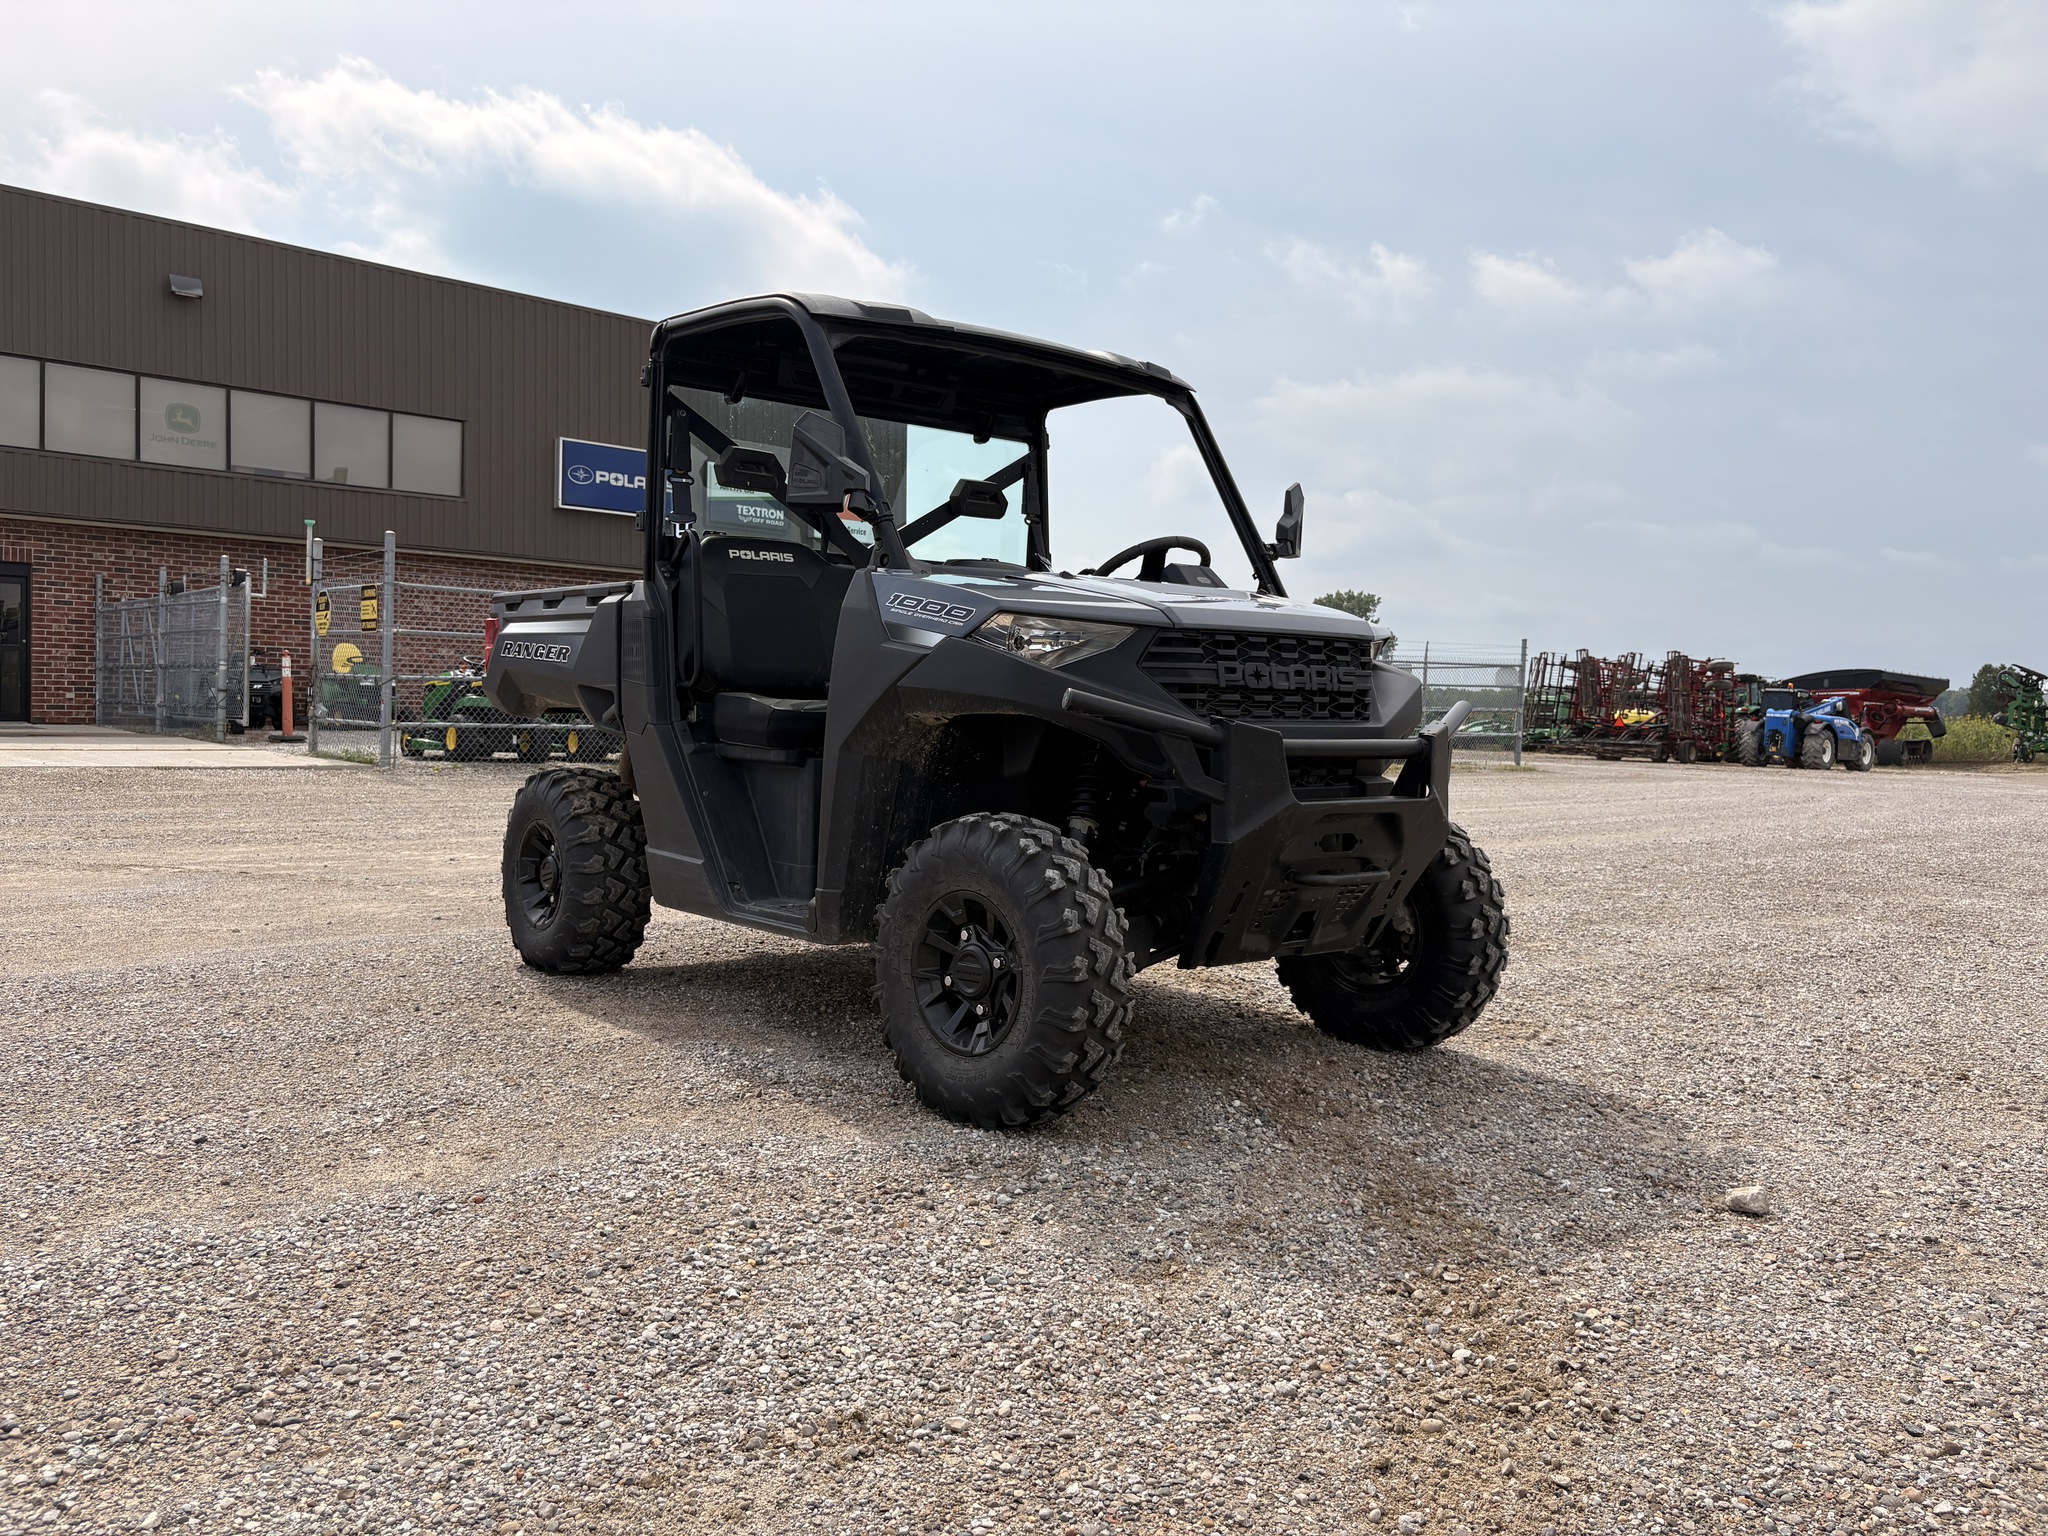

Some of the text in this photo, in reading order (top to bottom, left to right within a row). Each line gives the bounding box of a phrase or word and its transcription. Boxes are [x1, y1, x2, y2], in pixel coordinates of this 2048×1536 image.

[149, 433, 217, 449] JOHN DEERE
[736, 504, 784, 520] TEXTRON
[765, 519, 785, 527] ROAD
[847, 526, 867, 536] ervice
[728, 549, 795, 563] POLARIS
[885, 592, 976, 622] 1000
[500, 640, 572, 663] RANGER
[1217, 660, 1357, 692] POLARIS
